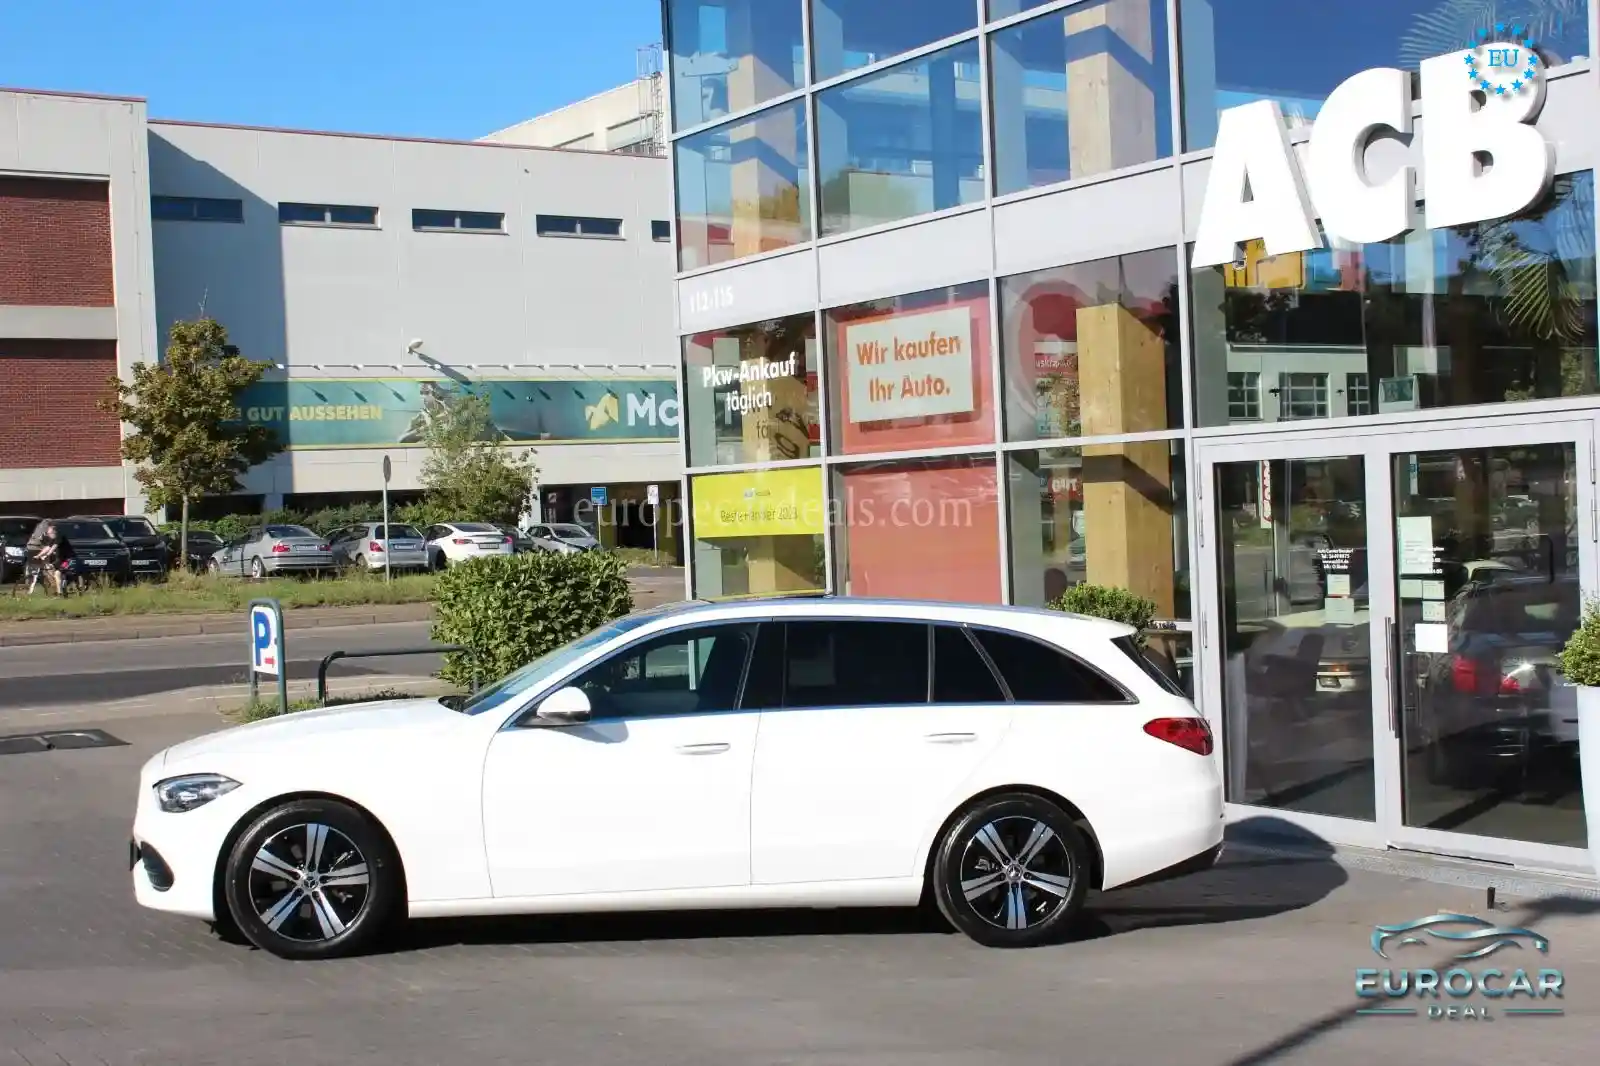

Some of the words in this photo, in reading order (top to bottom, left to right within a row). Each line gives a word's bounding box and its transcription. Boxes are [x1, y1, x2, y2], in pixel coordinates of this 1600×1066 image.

[1191, 42, 1556, 268] ACB
[856, 340, 888, 365] Wir
[894, 331, 963, 361] kaufen
[703, 352, 797, 388] Pkw-Ankauf
[726, 385, 772, 416] täglich
[869, 377, 895, 402] Ihr
[901, 374, 951, 400] Auto.
[247, 406, 284, 421] GUT
[288, 404, 382, 421] AUSSEHEN
[254, 612, 271, 666] P
